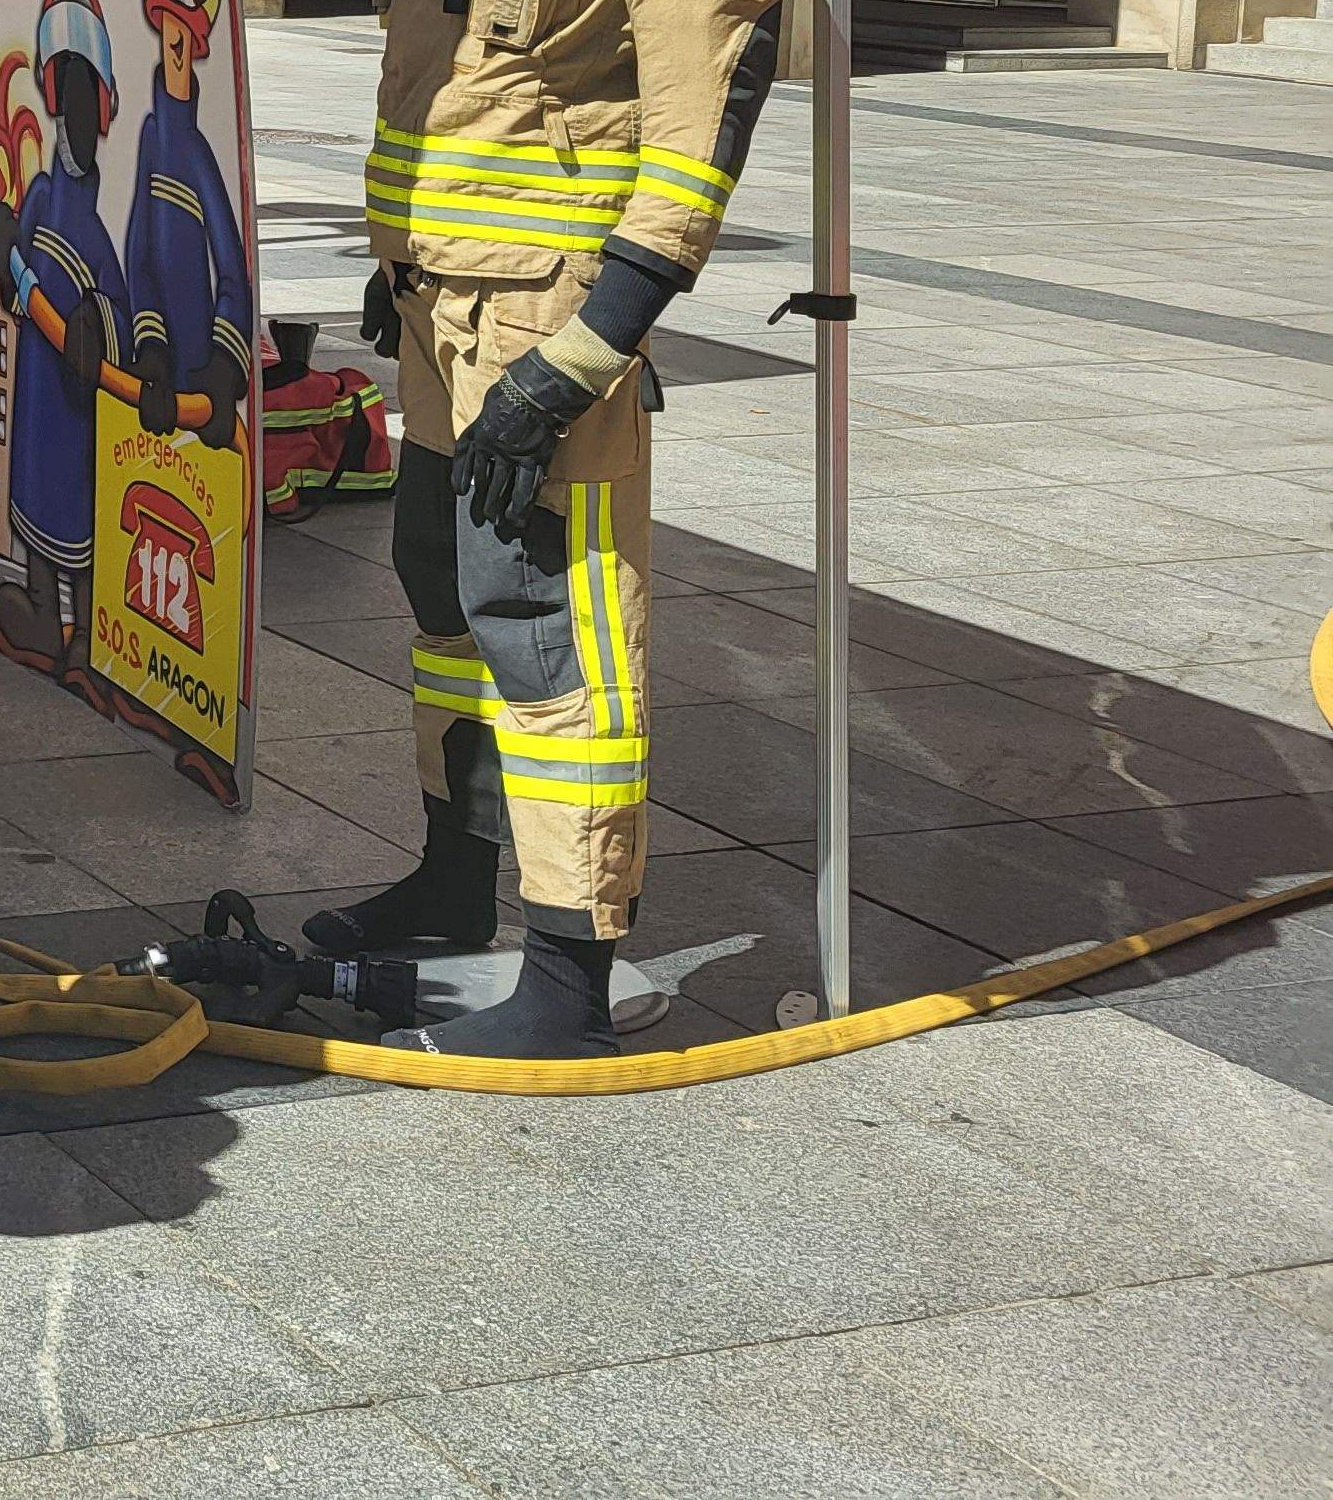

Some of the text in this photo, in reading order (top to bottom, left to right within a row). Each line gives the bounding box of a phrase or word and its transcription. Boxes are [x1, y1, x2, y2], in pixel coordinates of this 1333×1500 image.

[113, 432, 215, 518] emergencias
[138, 537, 190, 635] 112
[97, 605, 226, 730] S.O.S ARAGON
